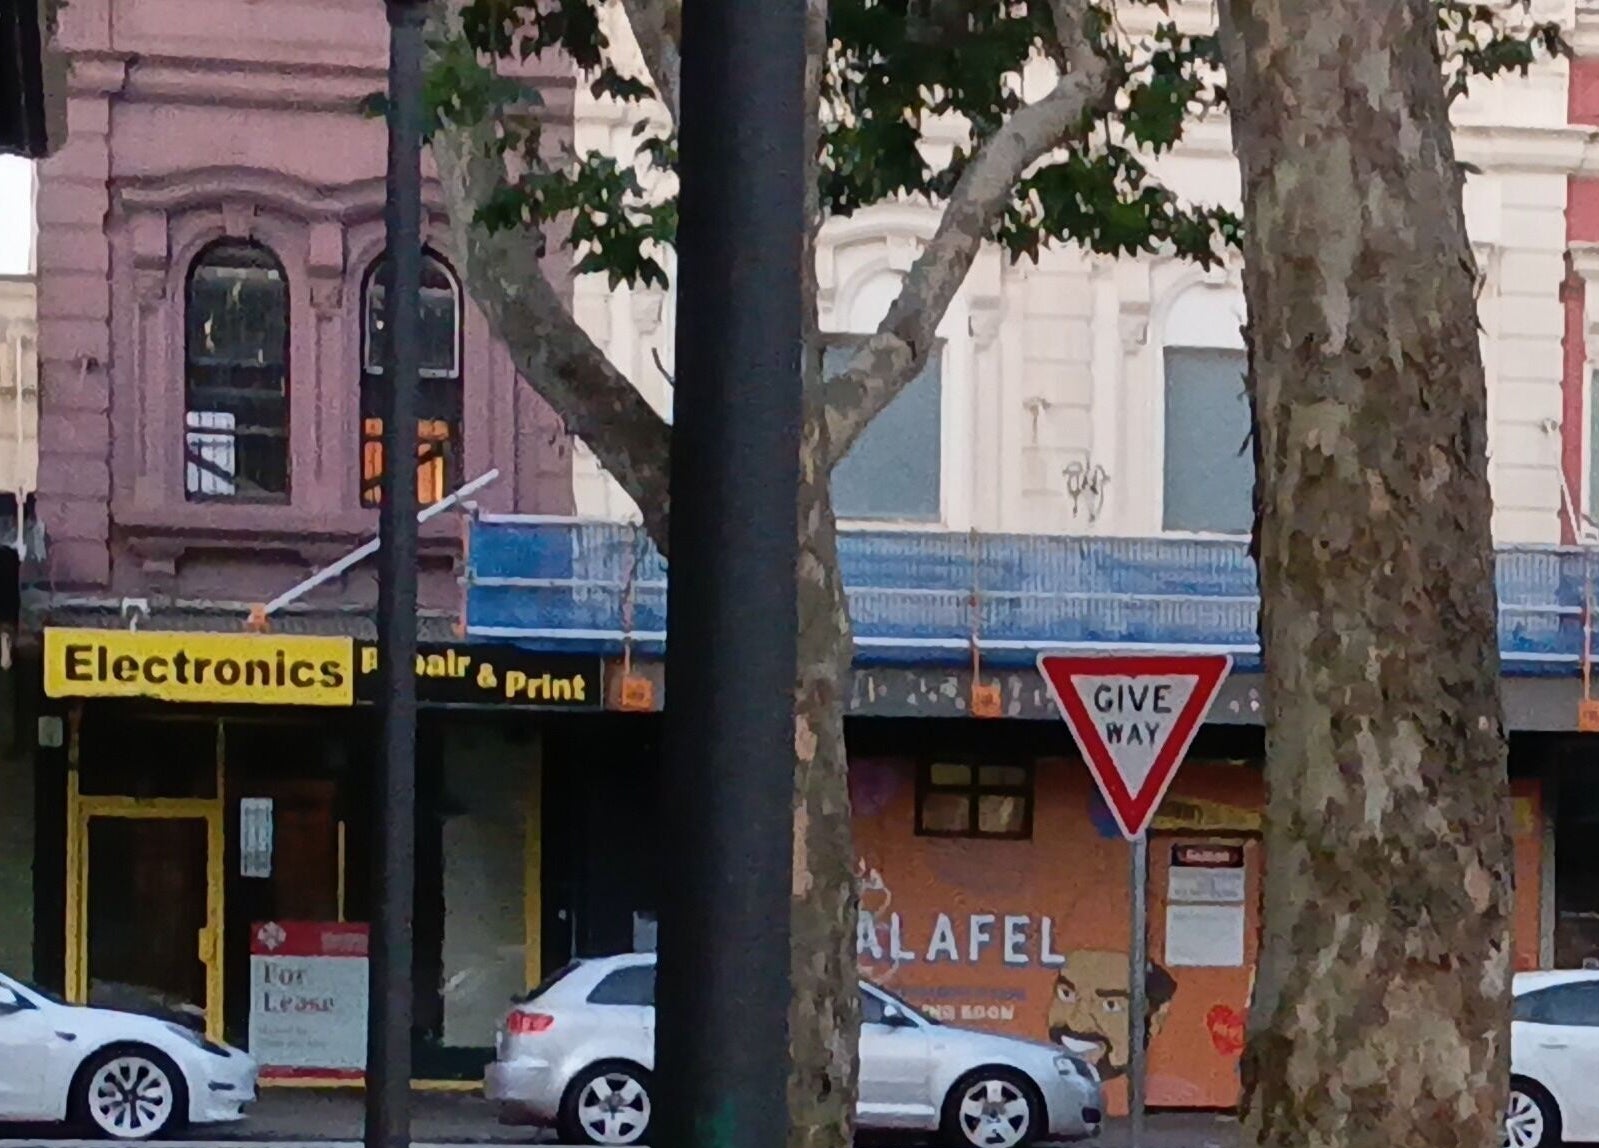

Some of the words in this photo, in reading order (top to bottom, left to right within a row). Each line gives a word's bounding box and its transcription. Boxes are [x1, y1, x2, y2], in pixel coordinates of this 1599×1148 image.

[65, 643, 344, 689] Electronics
[361, 646, 471, 678] Rair
[476, 662, 498, 689] &
[505, 670, 586, 701] Print
[1093, 683, 1172, 714] GIVE
[1105, 721, 1161, 747] WAY
[856, 911, 1066, 964] ALAFEL
